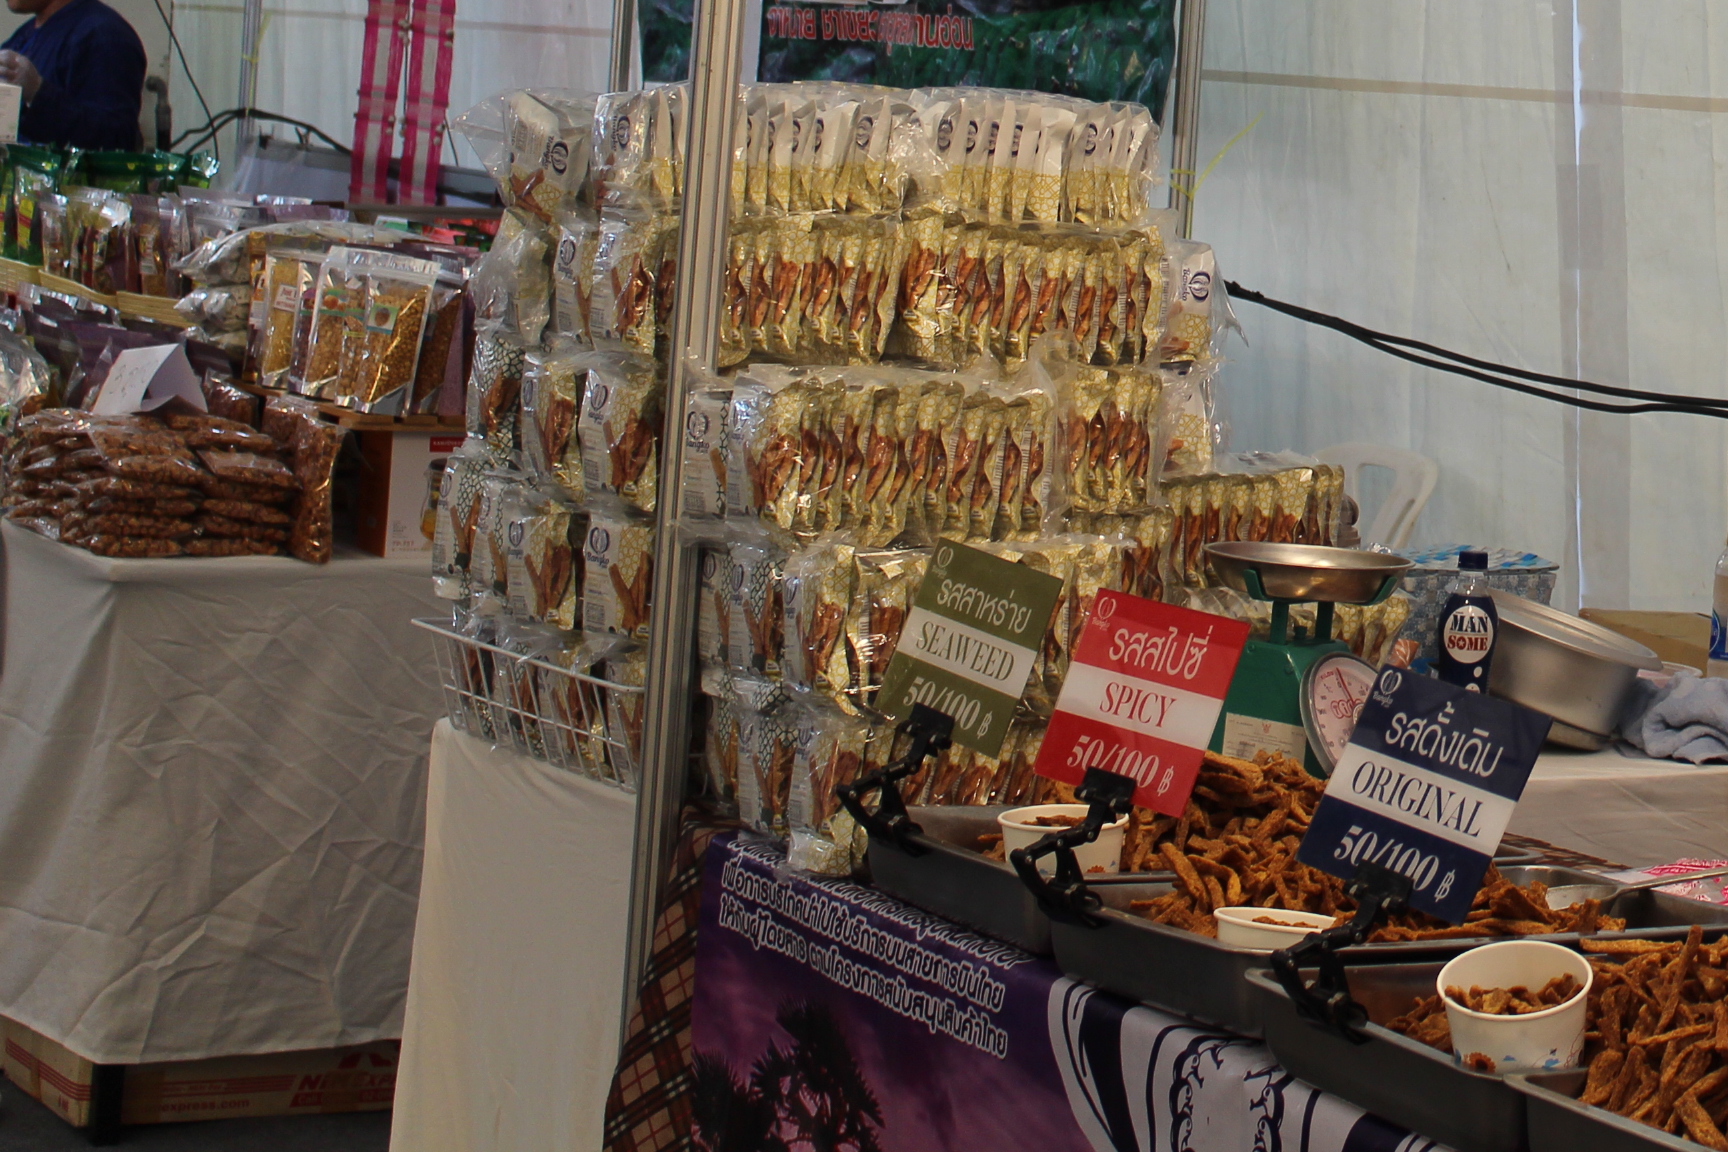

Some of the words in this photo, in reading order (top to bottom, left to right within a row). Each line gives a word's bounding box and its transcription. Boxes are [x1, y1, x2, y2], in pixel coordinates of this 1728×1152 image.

[937, 578, 1033, 635] รสสาหร่าย
[1449, 613, 1489, 634] MAN
[915, 620, 1016, 682] SEAWEED
[1108, 625, 1214, 681] รสสไปซี่
[1447, 634, 1489, 652] SOME
[1099, 681, 1178, 728] SPICY
[1384, 701, 1504, 778] รสดั้งเดิม
[1351, 760, 1484, 838] ORIGINAL
